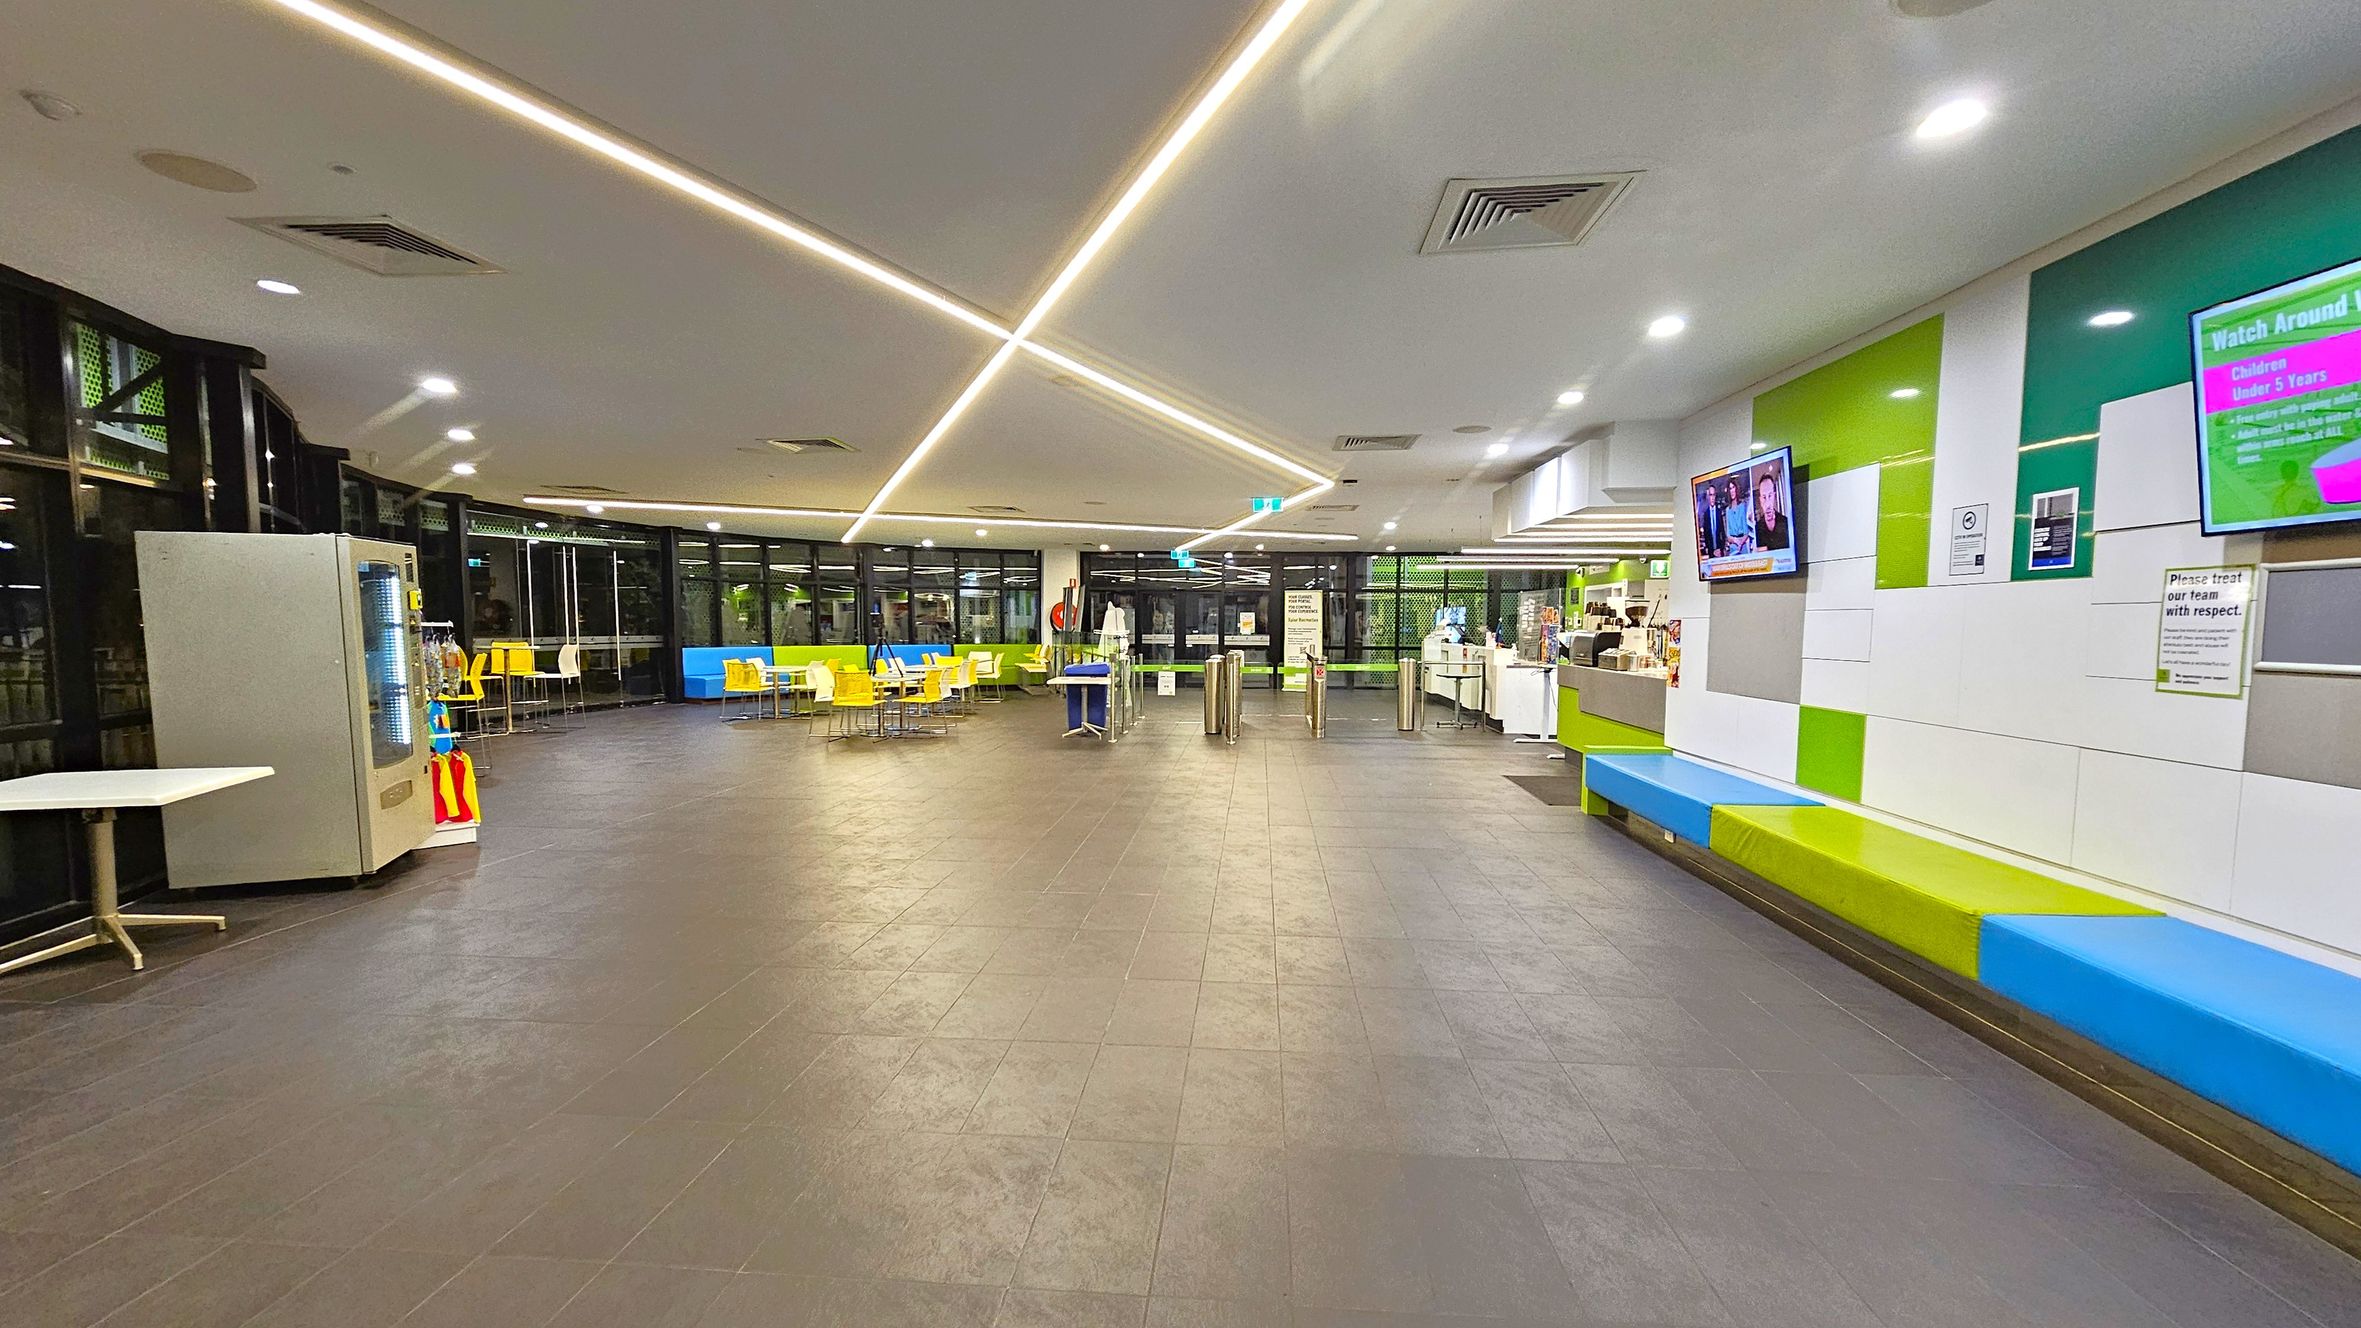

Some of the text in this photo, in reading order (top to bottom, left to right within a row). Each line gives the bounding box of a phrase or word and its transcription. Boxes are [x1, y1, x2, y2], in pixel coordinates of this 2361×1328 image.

[2212, 319, 2268, 352] Watch
[2274, 294, 2348, 334] Around
[2232, 358, 2287, 381] Children
[2233, 370, 2327, 400] Under 5 Years
[2170, 572, 2242, 586] Please treat
[2168, 590, 2218, 601] our team
[2166, 604, 2242, 619] with respect.
